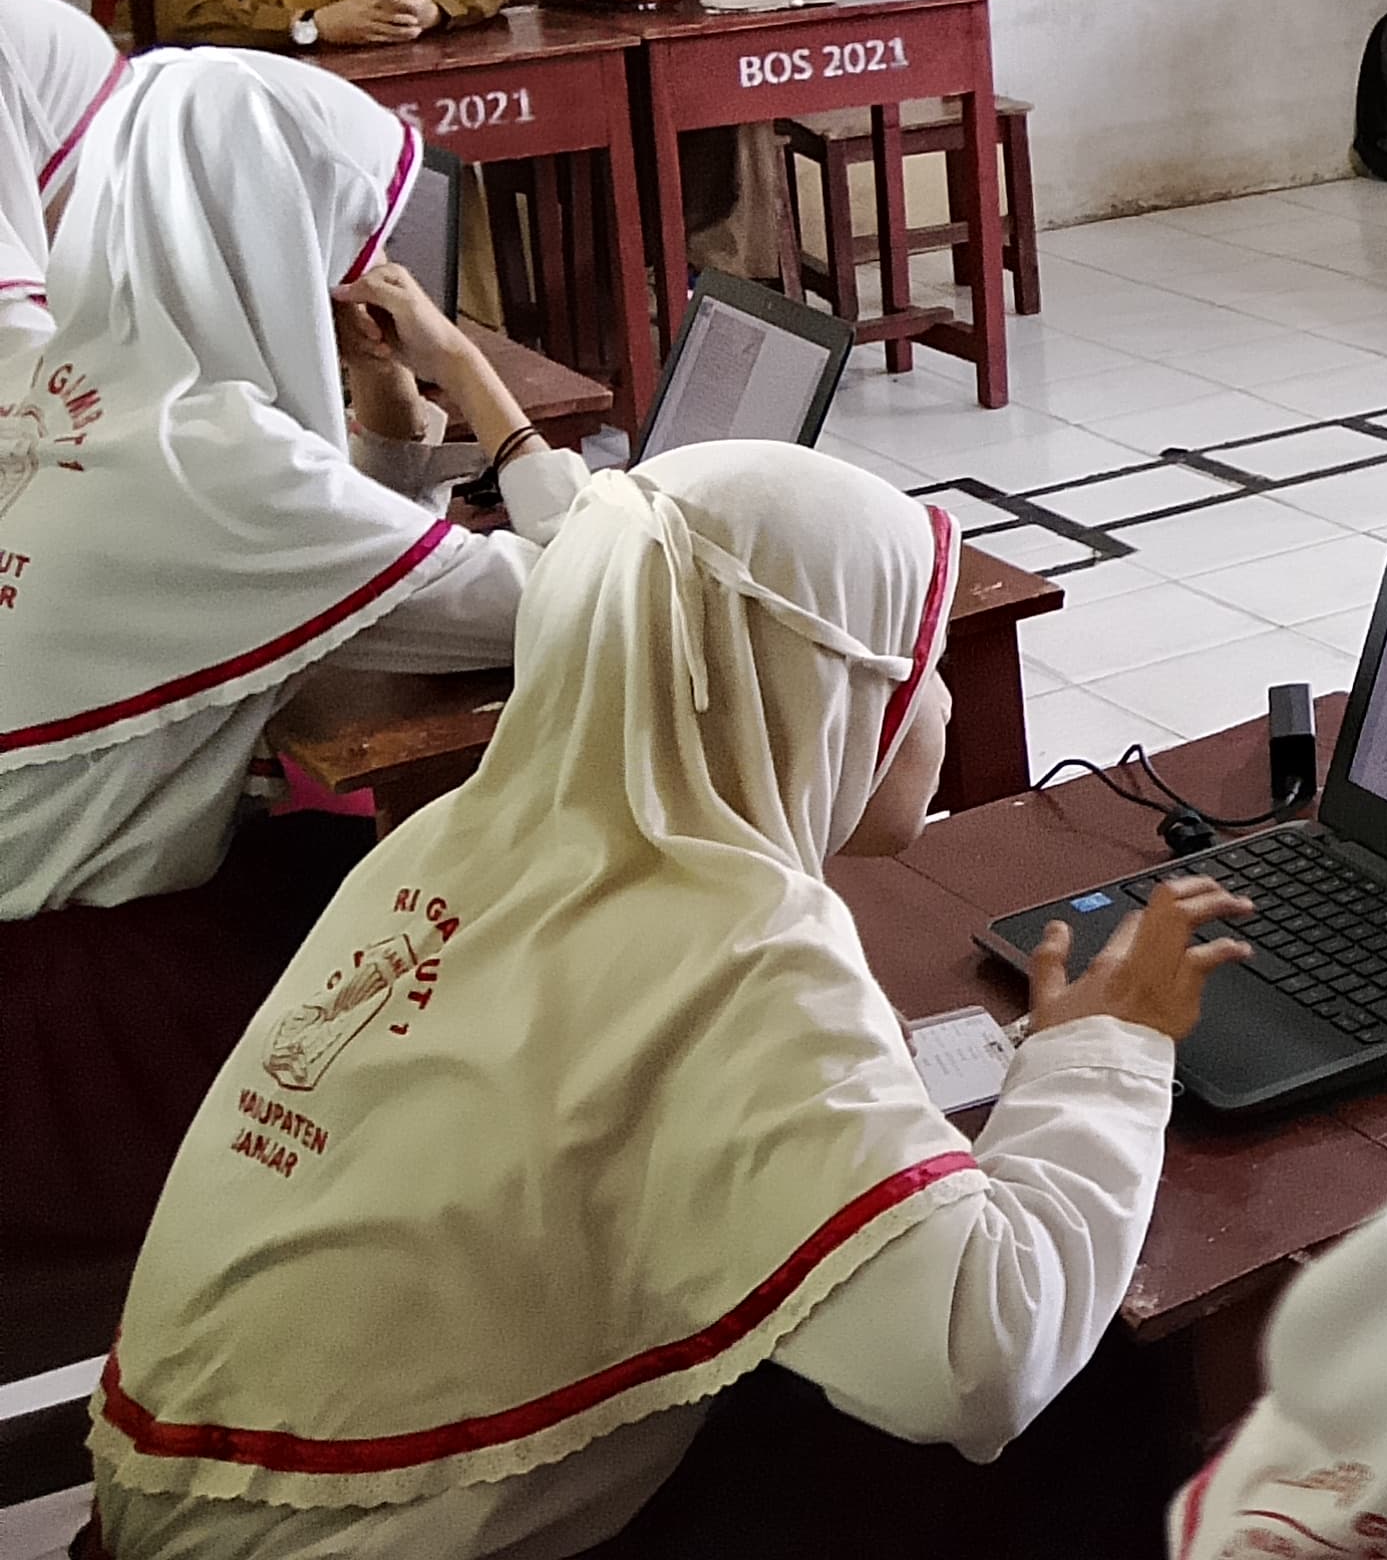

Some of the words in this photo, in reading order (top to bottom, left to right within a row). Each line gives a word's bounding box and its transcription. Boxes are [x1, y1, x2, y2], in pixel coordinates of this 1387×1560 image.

[738, 50, 814, 89] BOS
[823, 36, 910, 80] 2021
[435, 88, 537, 137] 2021
